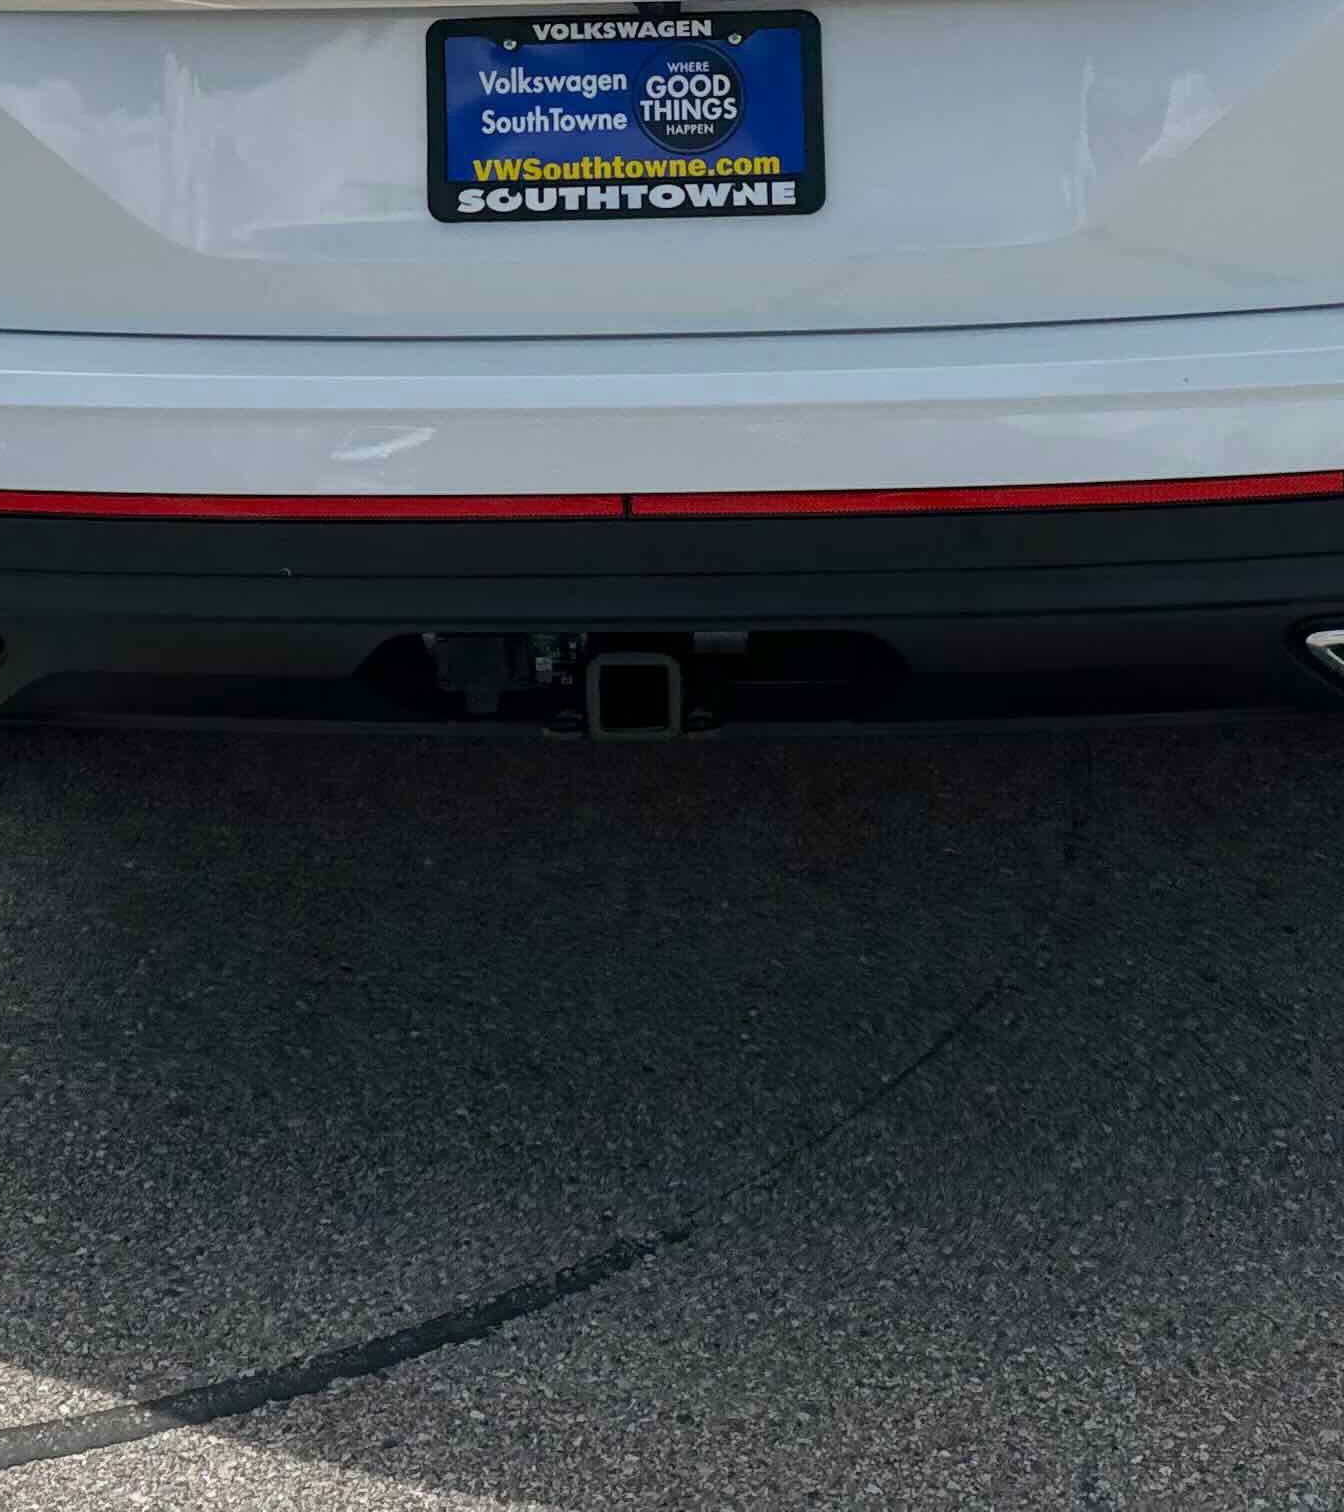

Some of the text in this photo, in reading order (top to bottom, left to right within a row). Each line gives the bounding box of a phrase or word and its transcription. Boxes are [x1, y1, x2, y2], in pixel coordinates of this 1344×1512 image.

[532, 19, 713, 41] VOLKSWAGEN
[667, 61, 710, 73] WHERE
[478, 67, 627, 100] Volkswagen
[646, 74, 731, 99] GOOD
[481, 106, 628, 134] SouthTowne
[640, 97, 738, 122] THINGS
[666, 123, 714, 136] HAPPEN
[473, 155, 781, 182] VWSouthtowne.com
[457, 181, 797, 213] SOUTHTOWNE
